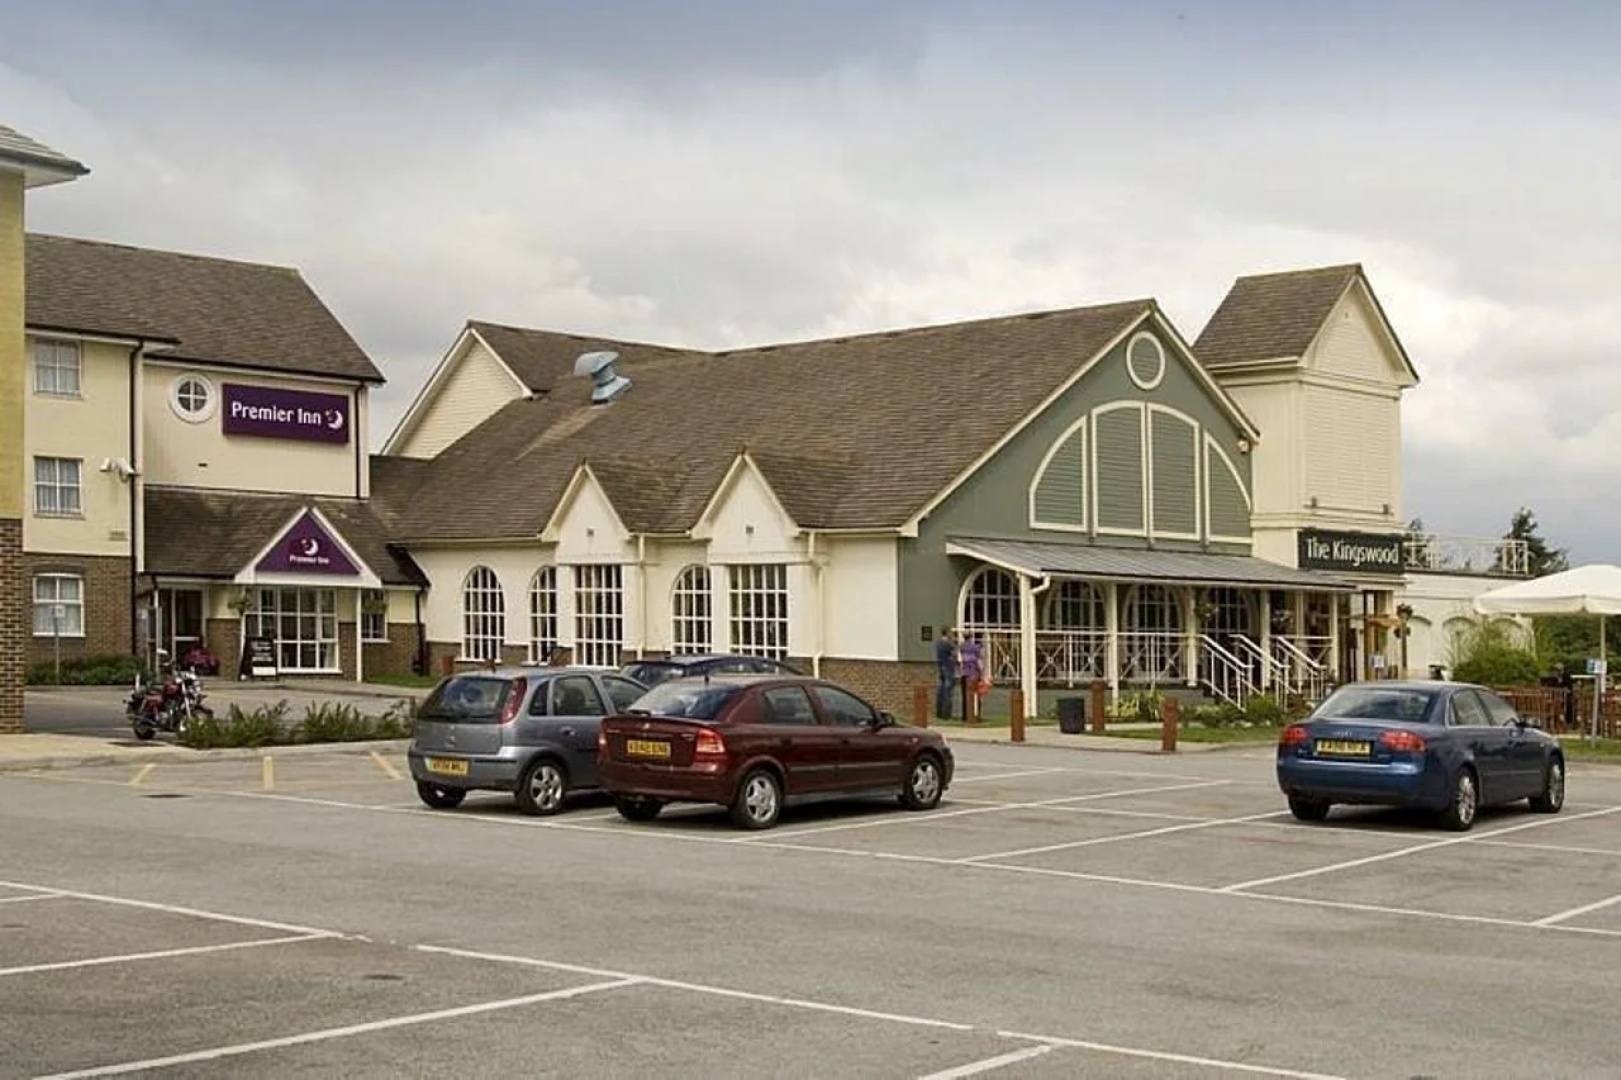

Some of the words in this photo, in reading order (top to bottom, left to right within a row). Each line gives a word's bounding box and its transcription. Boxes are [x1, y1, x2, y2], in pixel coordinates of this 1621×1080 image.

[232, 401, 294, 422] Premier
[297, 408, 321, 424] Inn
[1306, 537, 1330, 559] The
[1333, 540, 1399, 567] Kingswood
